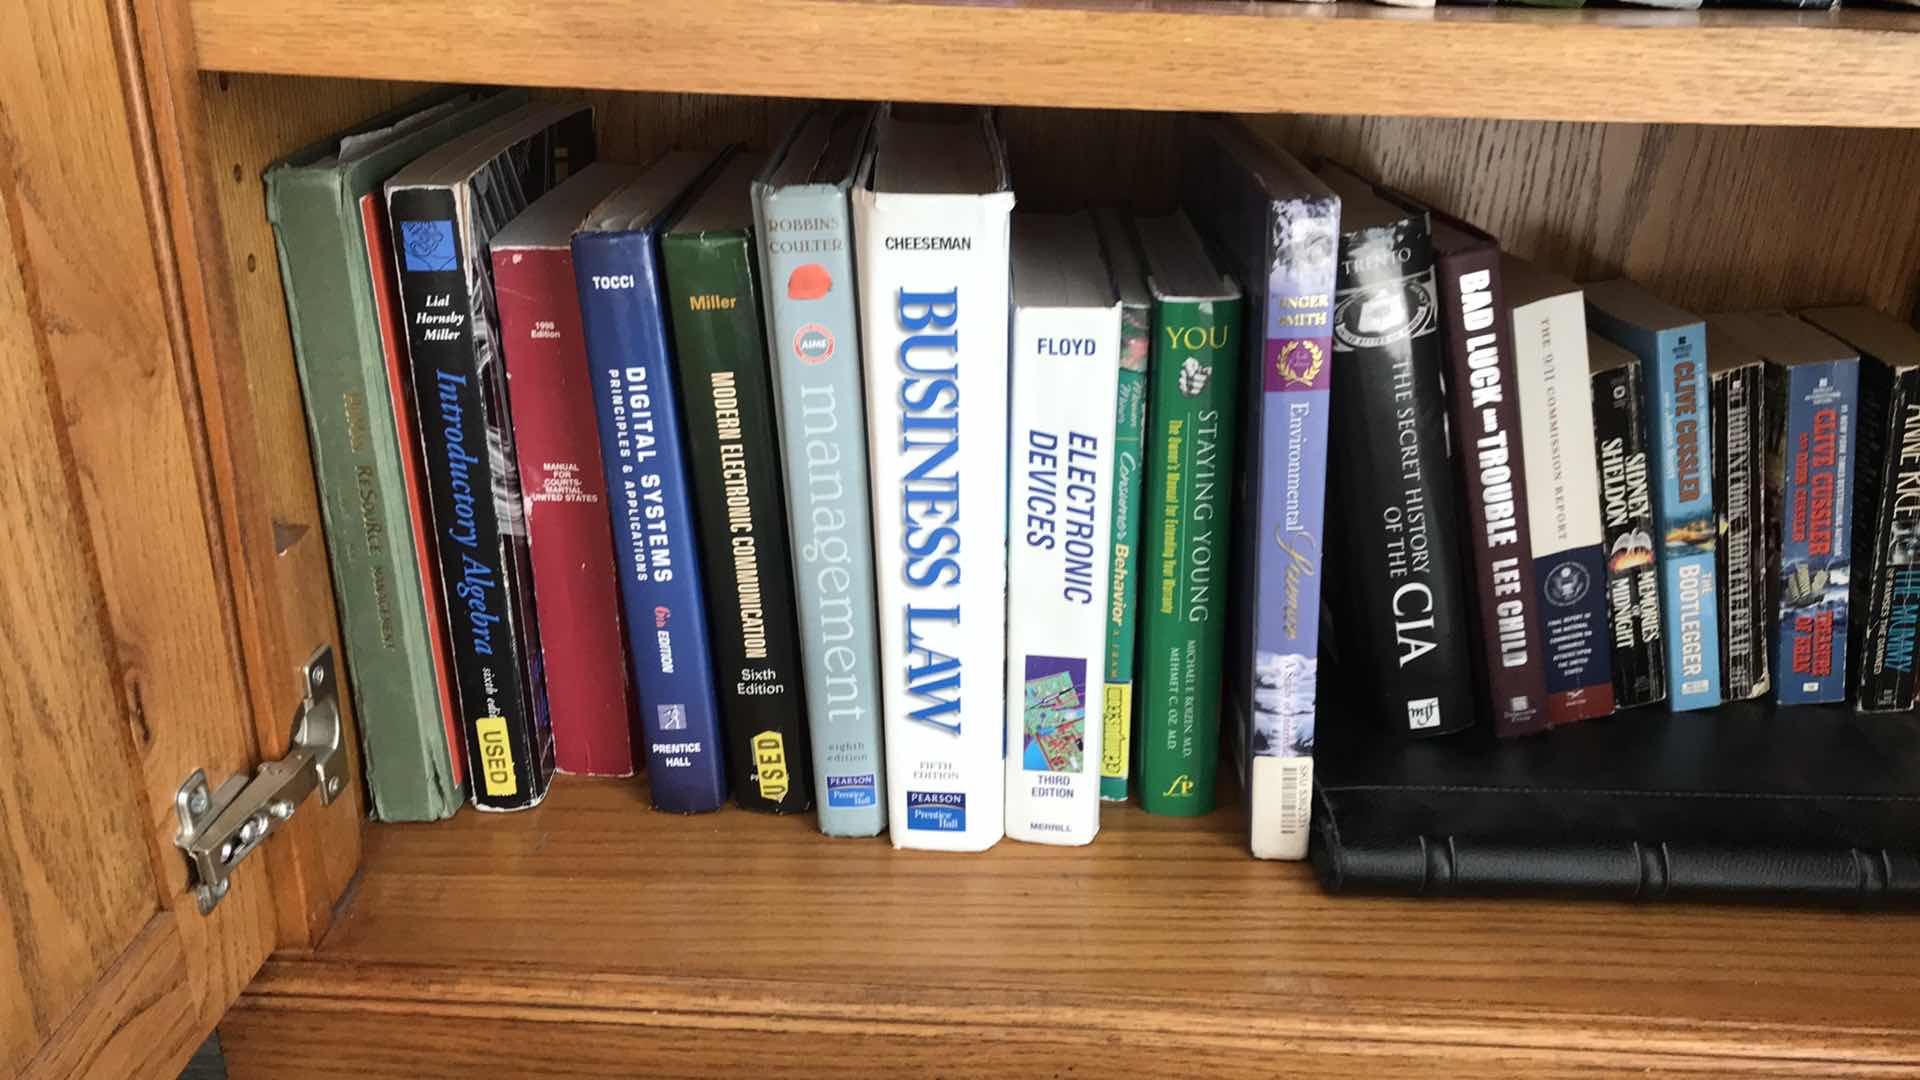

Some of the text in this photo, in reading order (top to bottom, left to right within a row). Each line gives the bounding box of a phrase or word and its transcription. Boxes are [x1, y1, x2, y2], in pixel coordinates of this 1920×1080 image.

[768, 217, 839, 233] ROBBINS
[770, 238, 843, 255] COULTER
[885, 236, 972, 251] CHEESEMAN
[592, 274, 634, 290] TOCCI
[1342, 247, 1411, 275] TRENTO
[415, 311, 465, 327] Hornsby
[426, 294, 450, 309] Lial
[689, 294, 737, 311] Miller
[1459, 268, 1495, 332] BAD
[424, 327, 460, 341] Miller
[530, 330, 561, 338] Edition
[1037, 337, 1097, 356] FLOYD
[1166, 325, 1228, 351] YOU
[1465, 333, 1503, 409] LUCK
[1673, 361, 1697, 417] CLIVE
[1482, 408, 1499, 433] AND
[1540, 317, 1568, 541] THE 9/11 COMMISSION REPORT
[1728, 406, 1749, 467] ROBIN
[1812, 408, 1838, 468] CLIVE
[543, 463, 580, 471] MANUAL
[552, 471, 572, 479] FOR
[608, 368, 648, 583] PRINCIPLES & APPLICATIONS
[625, 366, 672, 583] DIGITAL SYSTEMS
[1286, 402, 1310, 532] Environmental
[1392, 359, 1431, 574] THE SECRET HISTORY
[1601, 437, 1629, 529] SHELDON
[1676, 420, 1701, 503] CUSSLER
[1893, 403, 1920, 521] ANNE RICE
[531, 492, 599, 503] UNITED STATES
[1026, 428, 1058, 552] DEVICES
[1116, 450, 1137, 542] Consumer
[1477, 430, 1518, 550] TROUBLE
[1625, 452, 1650, 519] SIDNEY
[1728, 470, 1748, 520] COOK
[436, 368, 499, 657] Introductory Algebra
[710, 371, 768, 659] MODERN ELECTRONIC COMMUNICATION
[898, 285, 962, 737] BUSINESS LAW
[1064, 431, 1098, 605] ELECTRONIC
[1159, 420, 1184, 614] The Owner's Manual for Extending Your Warranty
[1189, 409, 1218, 623] STAYING YOUNG
[1791, 488, 1808, 542] CUSSLER
[1808, 470, 1835, 556] CUSSLER
[801, 382, 867, 721] management
[1383, 506, 1408, 578] OF THE
[1110, 543, 1130, 627] Behavior
[1491, 557, 1521, 597] LEE
[1702, 571, 1713, 595] THE
[1729, 529, 1750, 600] MORTAL
[1893, 569, 1920, 600] THE
[1611, 578, 1635, 648] MIDNIGHT
[1637, 570, 1660, 644] MEMORIES
[1679, 564, 1702, 676] BOOTLEGGER
[1880, 580, 1894, 617] RAMSES
[1392, 580, 1438, 668] CIA
[1496, 599, 1528, 668] CHILD
[1730, 603, 1751, 657] FEAR
[1794, 616, 1813, 632] OF
[1811, 610, 1834, 677] TREASURE
[1885, 604, 1920, 673] MUMMY
[657, 630, 674, 674] EDITION
[1169, 647, 1181, 692] MEHMET
[1185, 639, 1197, 685] MICHAEL
[1793, 635, 1812, 673] KHAN
[1873, 638, 1886, 675] DAMNED
[482, 666, 498, 695] sixth
[737, 682, 785, 696] Edition
[741, 668, 777, 682] Sixth
[483, 730, 509, 784] USED
[652, 742, 701, 753] PRENTICE
[665, 755, 691, 767] HALL
[757, 738, 786, 795] USED
[827, 753, 869, 761] edition
[828, 741, 865, 752] eighth
[920, 760, 953, 770] FIFTH
[830, 776, 873, 786] PEARSON
[833, 791, 866, 800] Prentice
[913, 770, 960, 780] EDITION
[1031, 786, 1075, 799] EDITION
[1037, 774, 1071, 786] THIRD
[854, 796, 872, 805] Hall
[911, 792, 962, 803] PEARSON
[914, 809, 953, 820] Prentice
[939, 818, 959, 829] Hall
[1030, 822, 1073, 833] MERRILL
